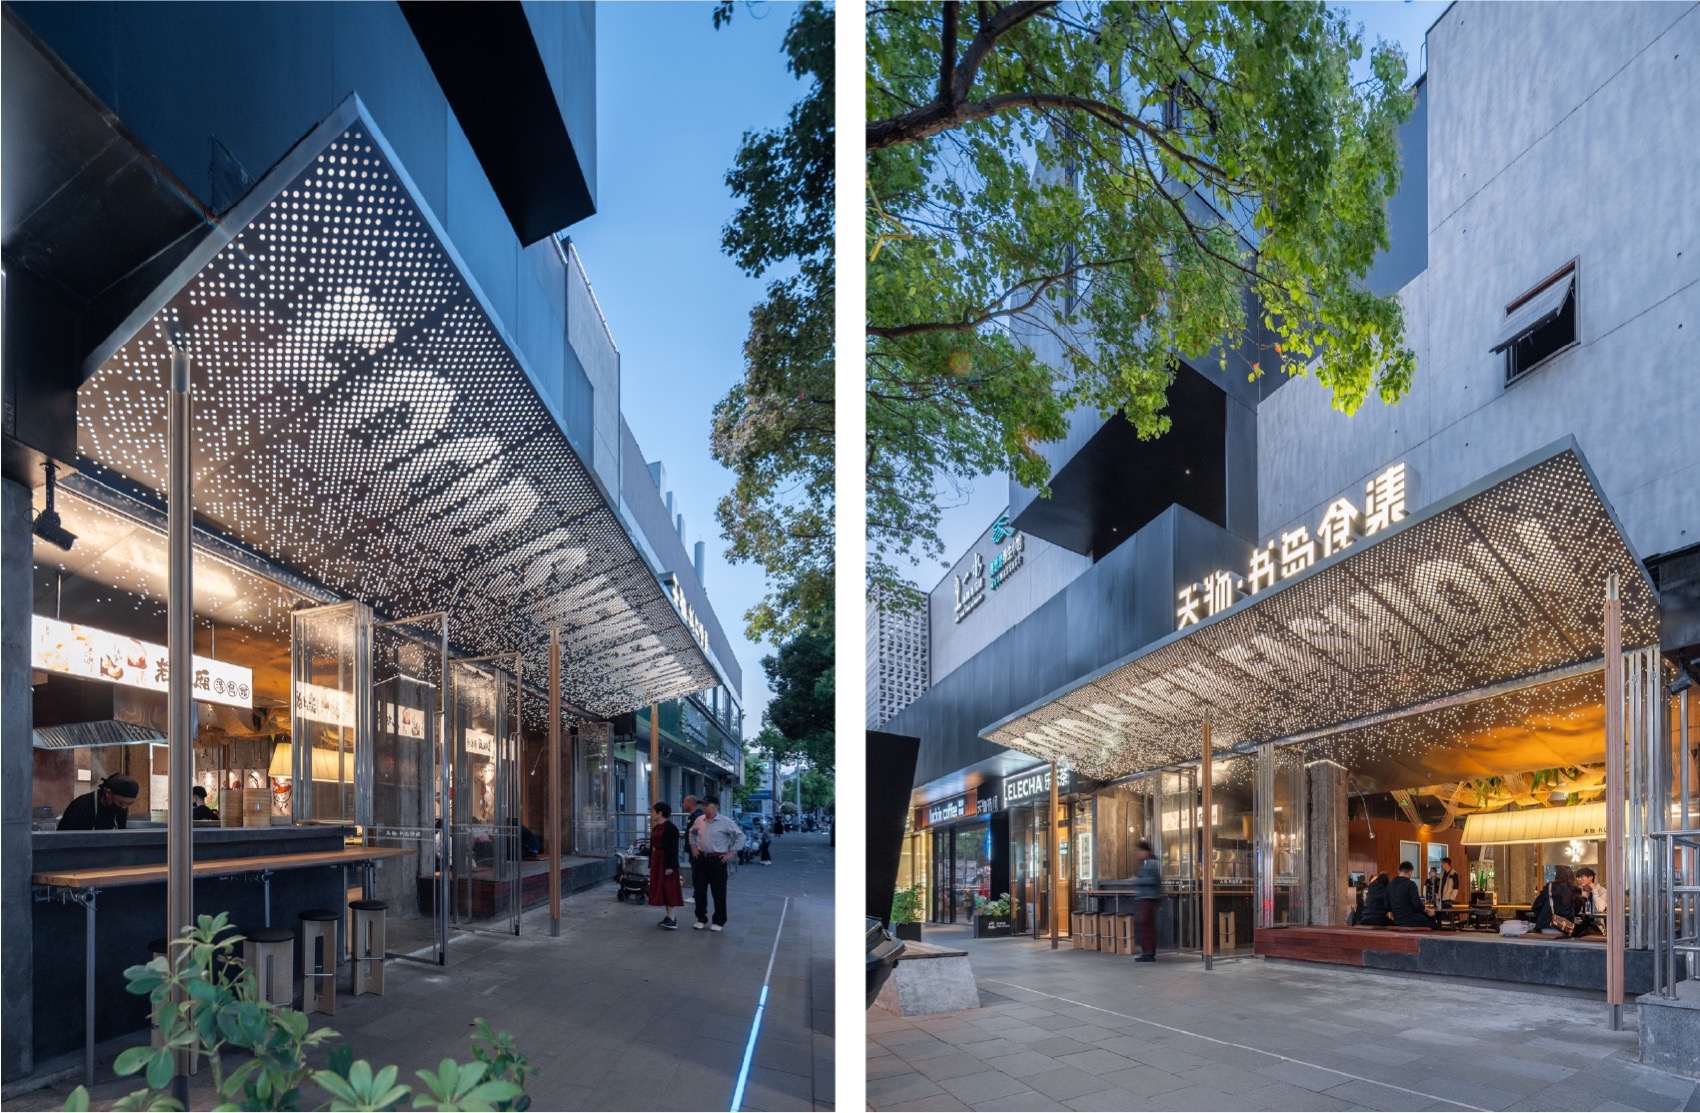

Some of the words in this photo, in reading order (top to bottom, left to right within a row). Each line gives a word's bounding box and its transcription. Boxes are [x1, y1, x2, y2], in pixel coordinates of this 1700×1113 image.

[155, 657, 210, 691] 老厢
[1044, 767, 1069, 791] 乐茶
[943, 802, 958, 820] coffee
